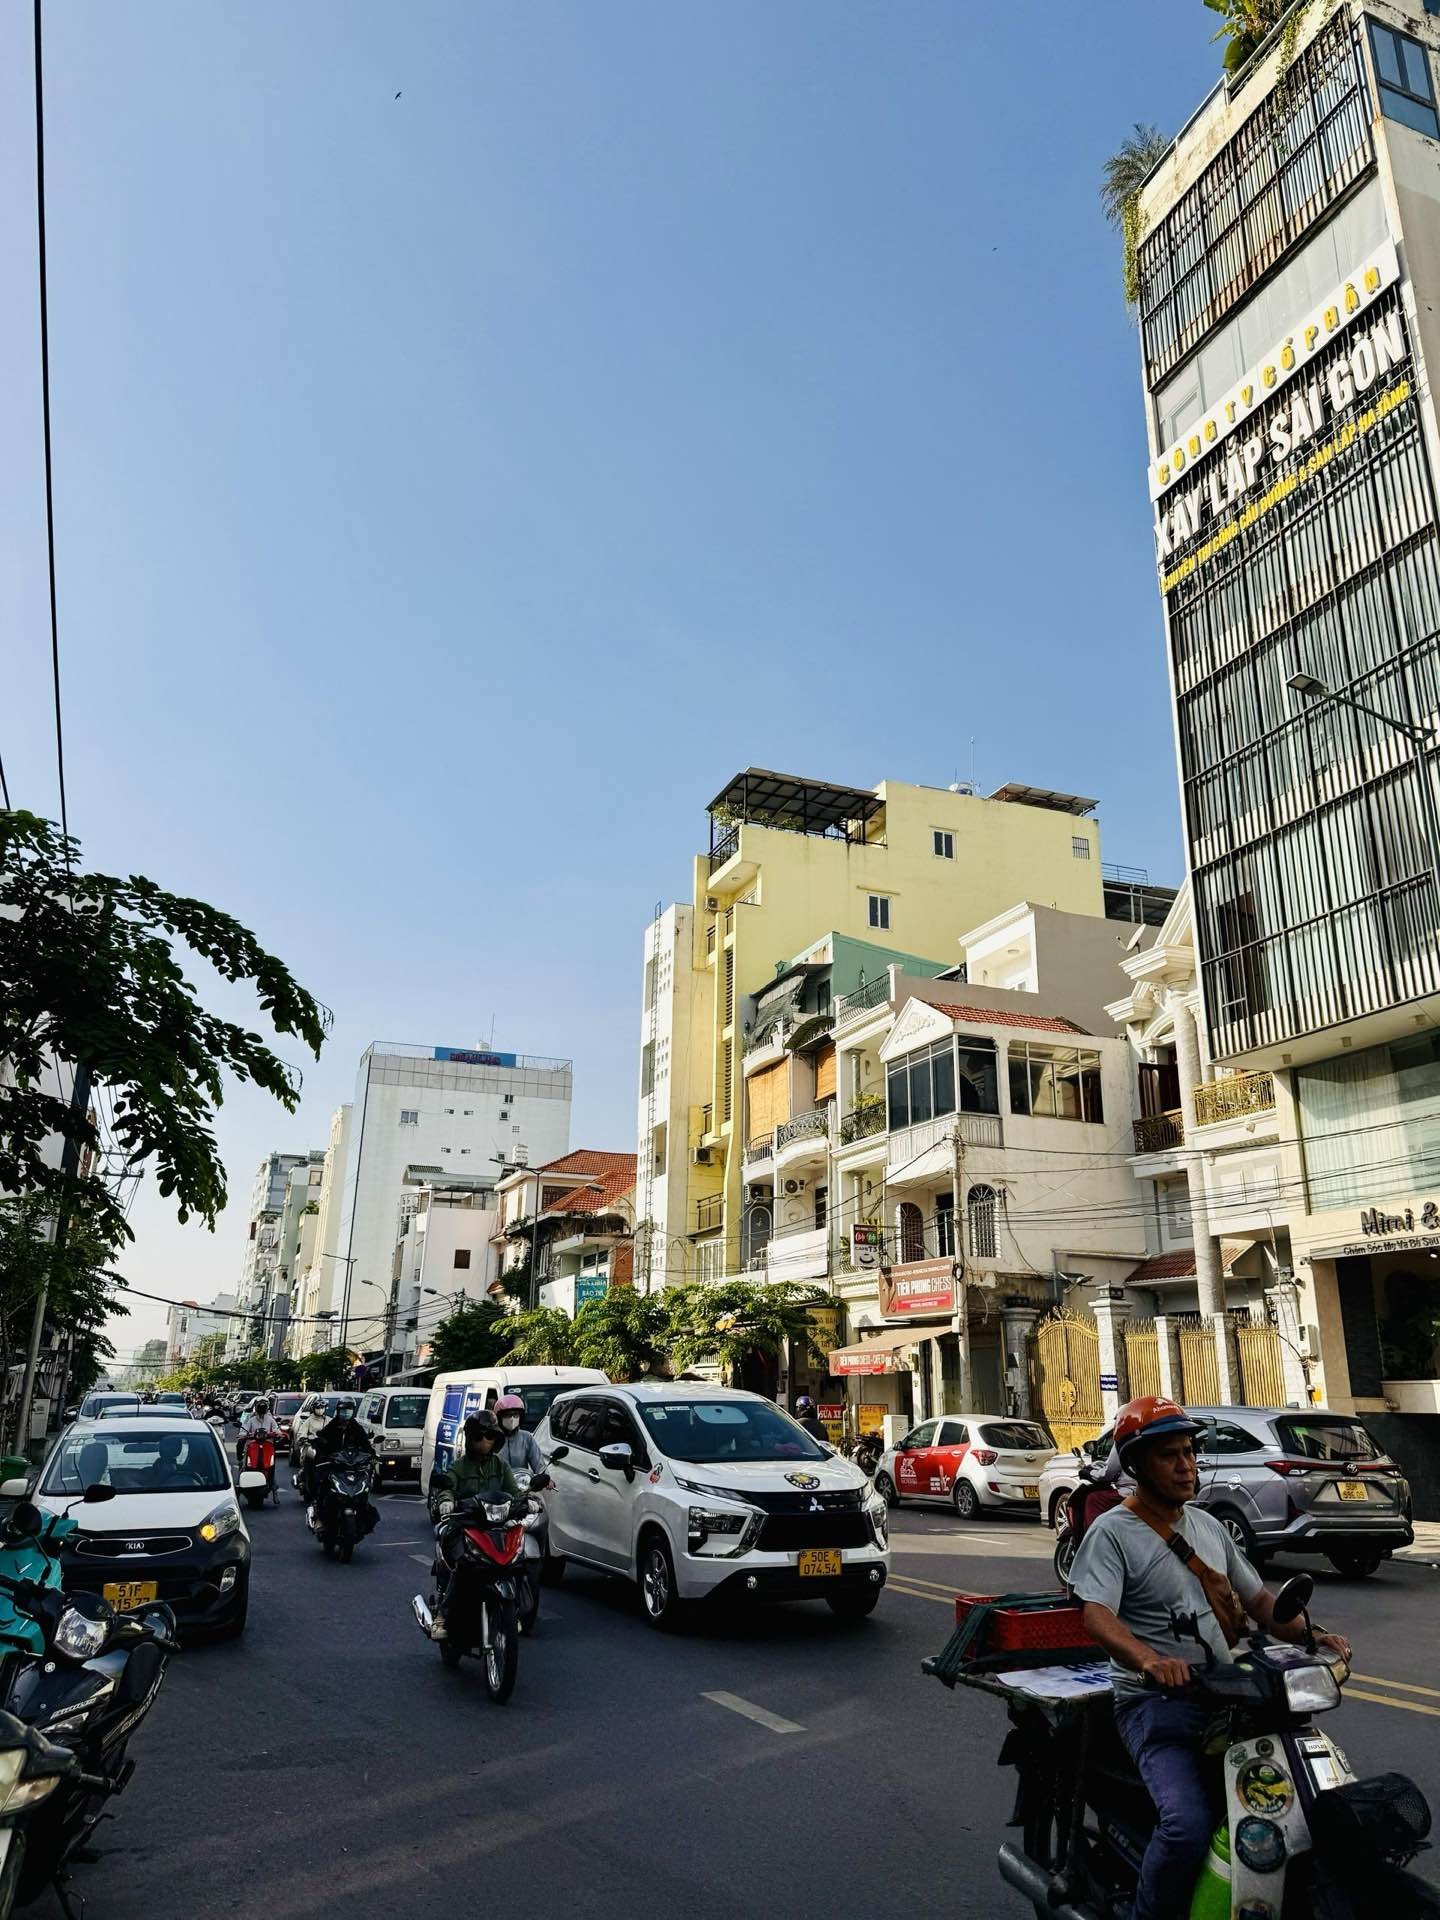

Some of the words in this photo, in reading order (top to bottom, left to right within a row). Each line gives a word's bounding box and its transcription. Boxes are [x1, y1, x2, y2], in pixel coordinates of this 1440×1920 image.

[1154, 484, 1202, 560] XÂY
[1270, 383, 1323, 462] SÀI
[1327, 311, 1405, 412] GÒN
[1159, 420, 1217, 485] CÔNG
[1224, 385, 1253, 423] TY
[1298, 465, 1308, 482] &
[1308, 444, 1332, 472] SAN
[1421, 1201, 1440, 1230] &
[127, 1542, 143, 1550] KIA
[811, 1551, 829, 1562] 50E
[804, 1563, 837, 1574] 074.54
[119, 1584, 142, 1597] 51F
